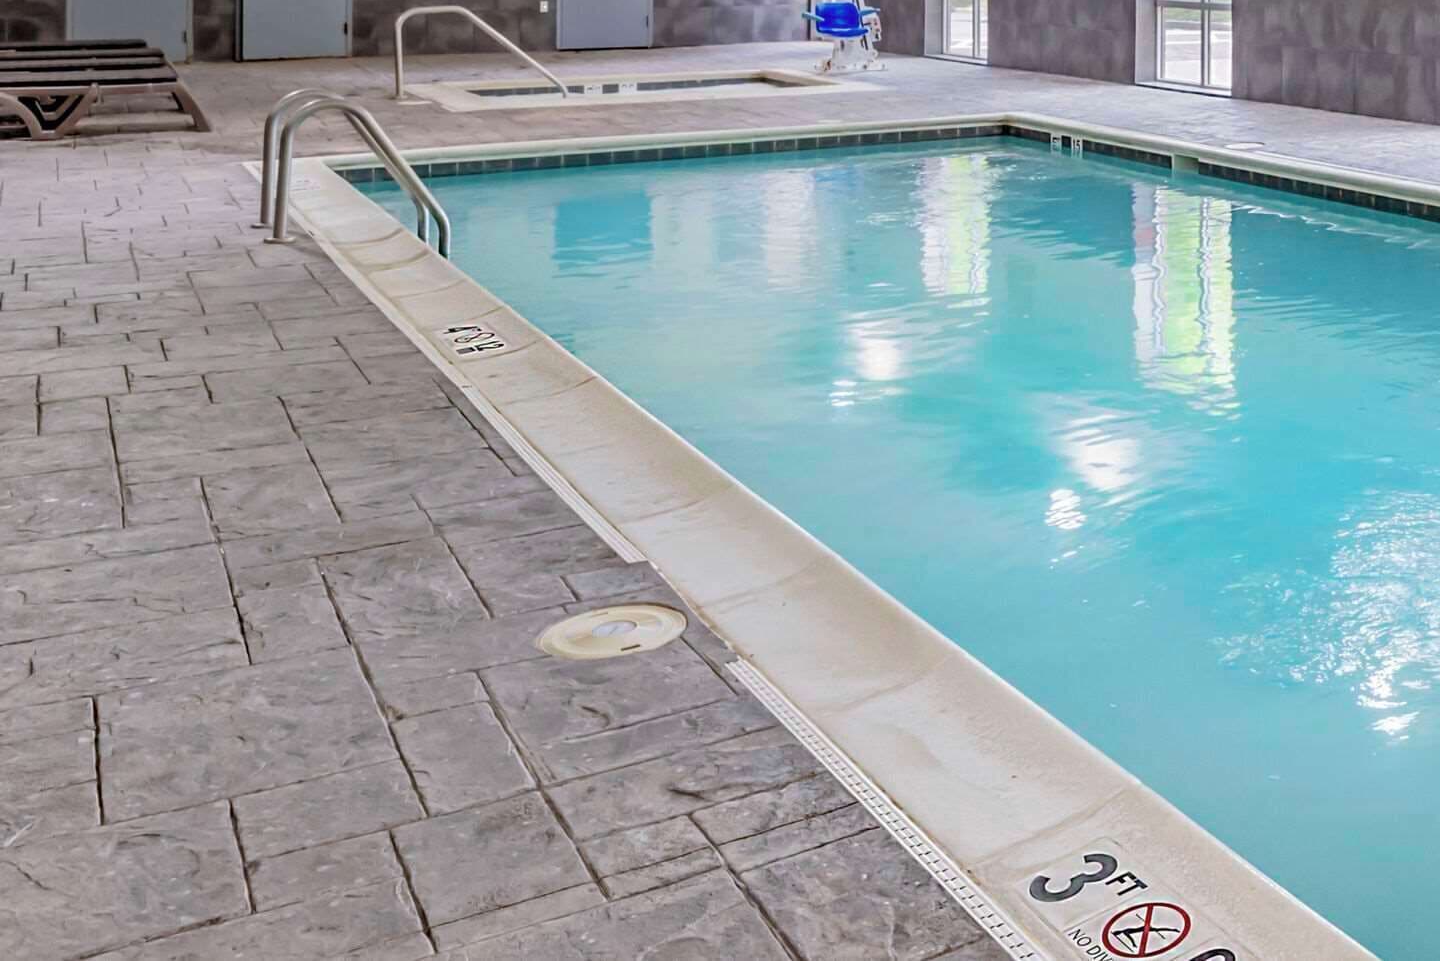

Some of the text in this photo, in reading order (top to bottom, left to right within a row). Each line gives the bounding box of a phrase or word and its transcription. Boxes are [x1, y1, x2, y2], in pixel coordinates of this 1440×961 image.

[1029, 853, 1149, 903] 3 FT
[1068, 928, 1092, 947] NO
